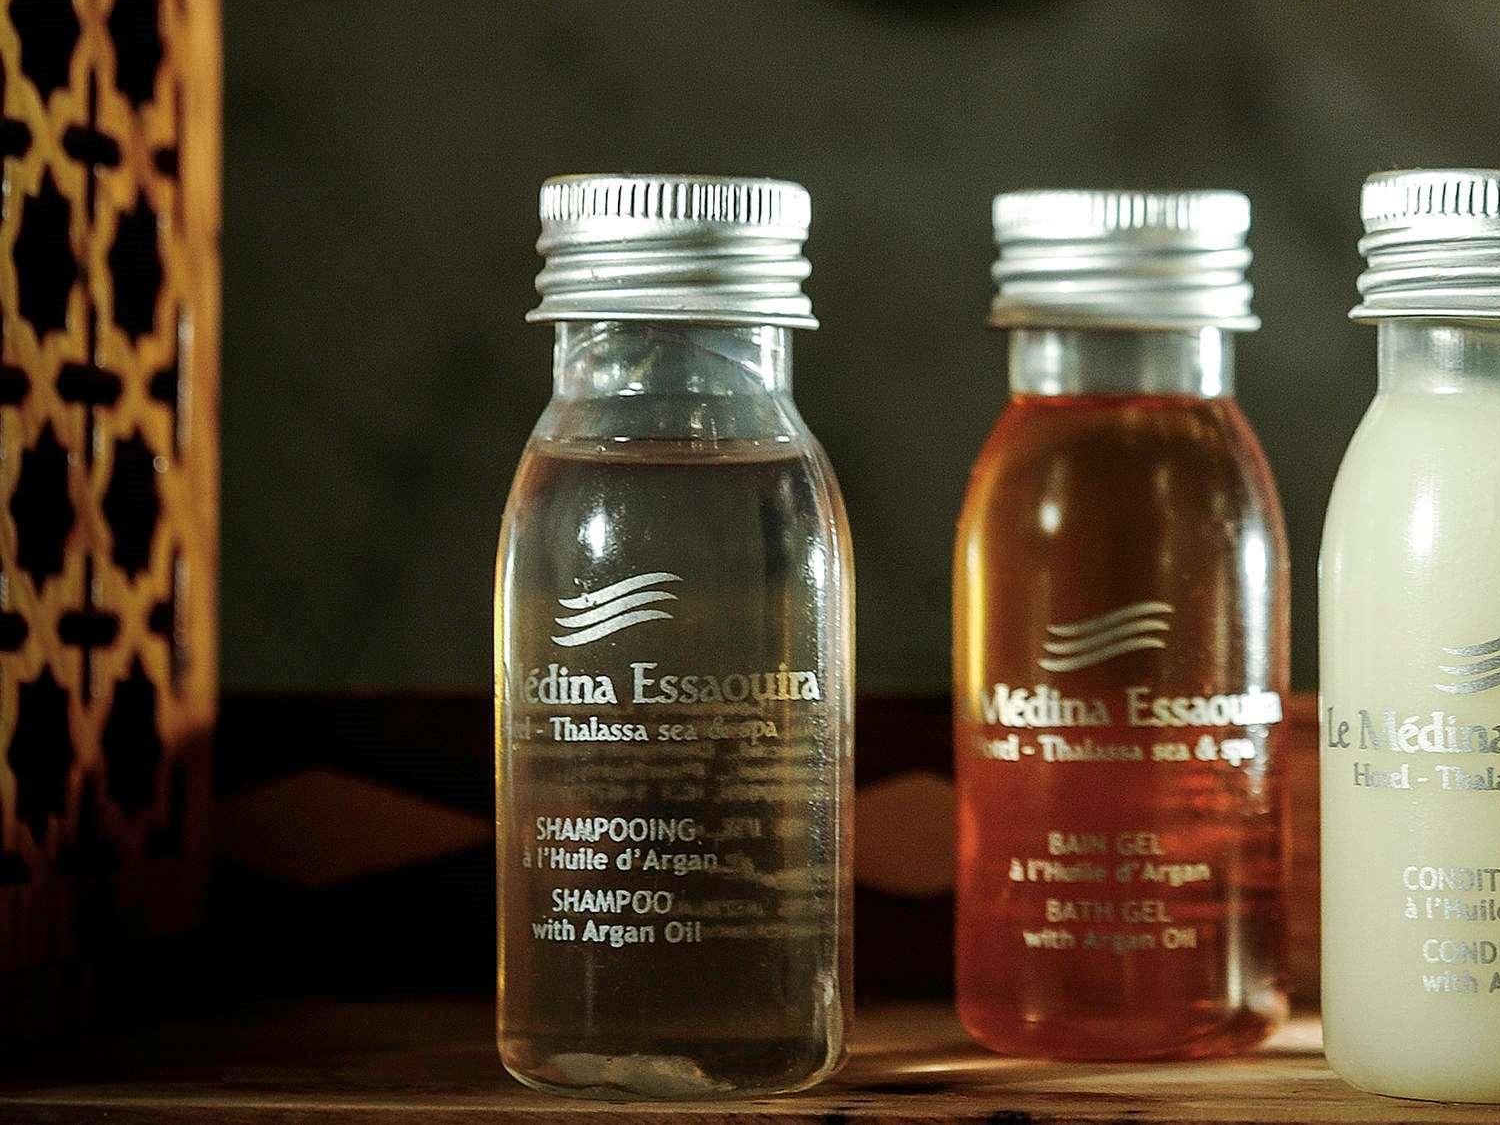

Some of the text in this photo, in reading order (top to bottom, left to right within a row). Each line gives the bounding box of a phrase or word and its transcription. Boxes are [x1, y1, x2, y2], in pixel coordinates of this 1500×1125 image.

[630, 662, 822, 705] Essaouira
[550, 716, 650, 741] Thalassa
[657, 724, 698, 741] sea
[1327, 706, 1351, 749] Le
[1353, 762, 1411, 789] Hotel
[536, 817, 696, 842] SHAMPOOING
[1048, 831, 1166, 856] BAIN GEL
[522, 847, 531, 868] à
[537, 848, 608, 870] l'Huile
[551, 889, 673, 914] SHAMPOO
[1045, 898, 1172, 924] BATH GEL
[1404, 896, 1419, 919] à
[532, 920, 701, 948] with Argan Oil
[1023, 928, 1076, 950] with
[1162, 927, 1197, 950] Oil
[1422, 970, 1479, 994] with
